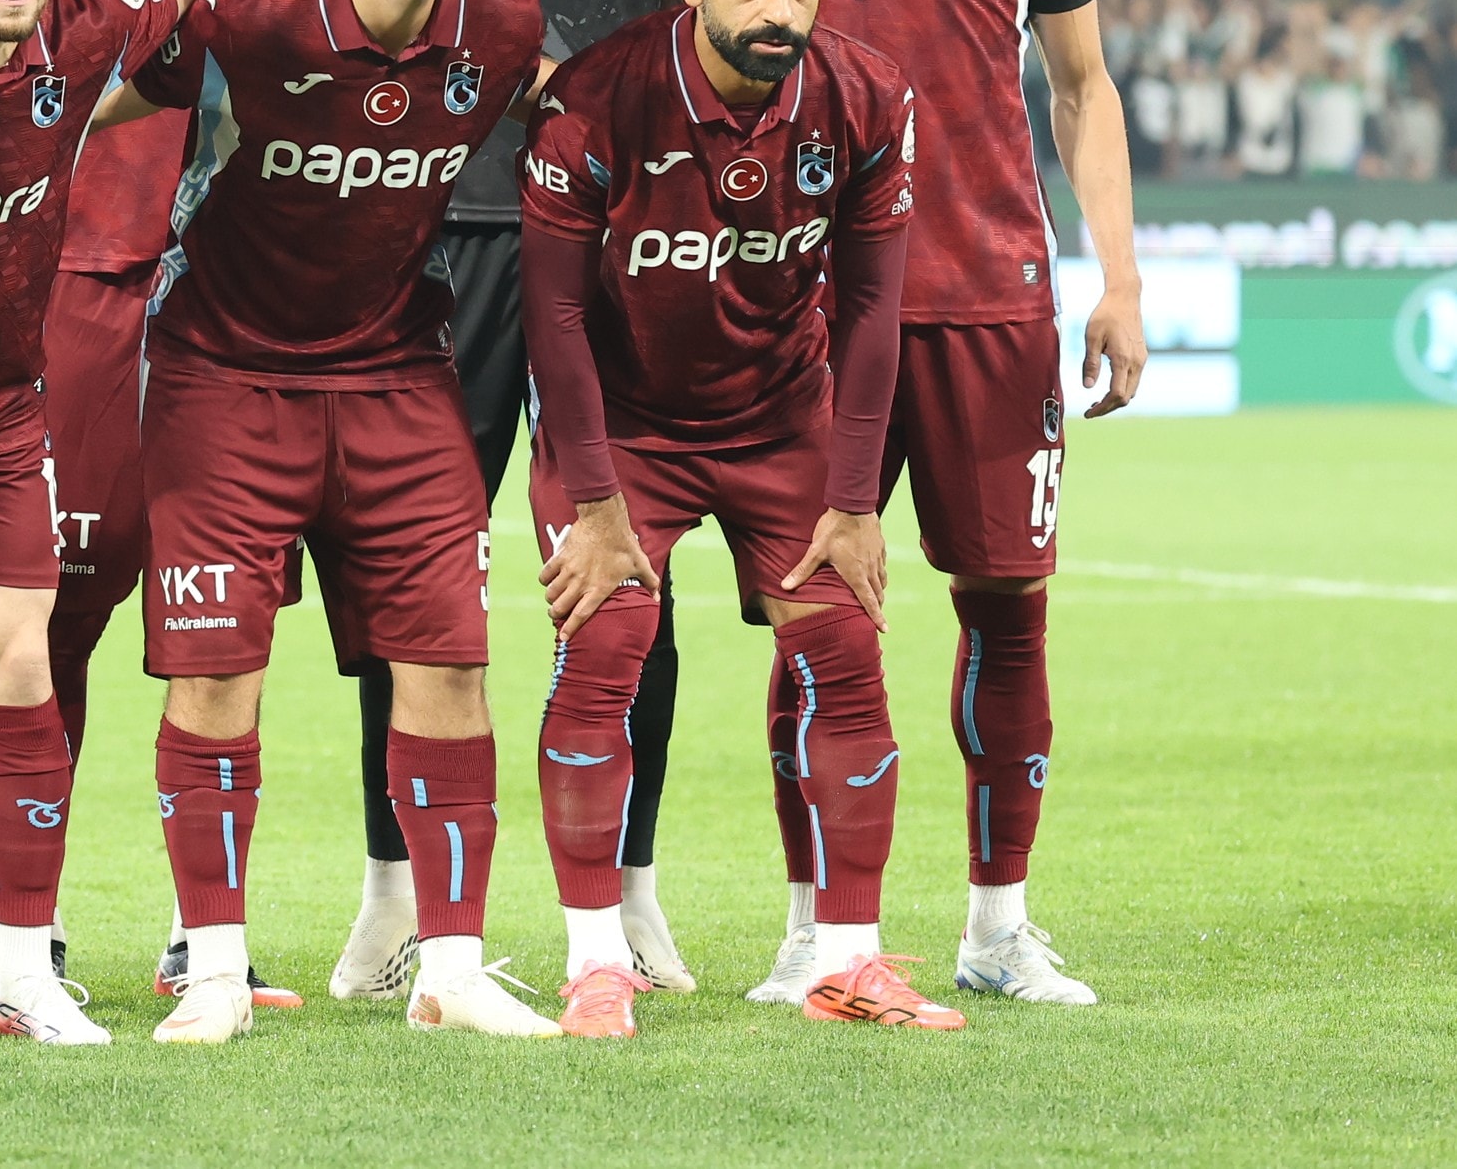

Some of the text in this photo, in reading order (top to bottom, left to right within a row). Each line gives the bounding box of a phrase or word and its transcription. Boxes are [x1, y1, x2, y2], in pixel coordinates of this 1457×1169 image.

[260, 139, 471, 198] papara
[525, 149, 570, 194] NB
[627, 215, 830, 283] papara
[1026, 448, 1062, 527] 15
[158, 563, 236, 606] YKT
[177, 615, 238, 630] Kiralama
